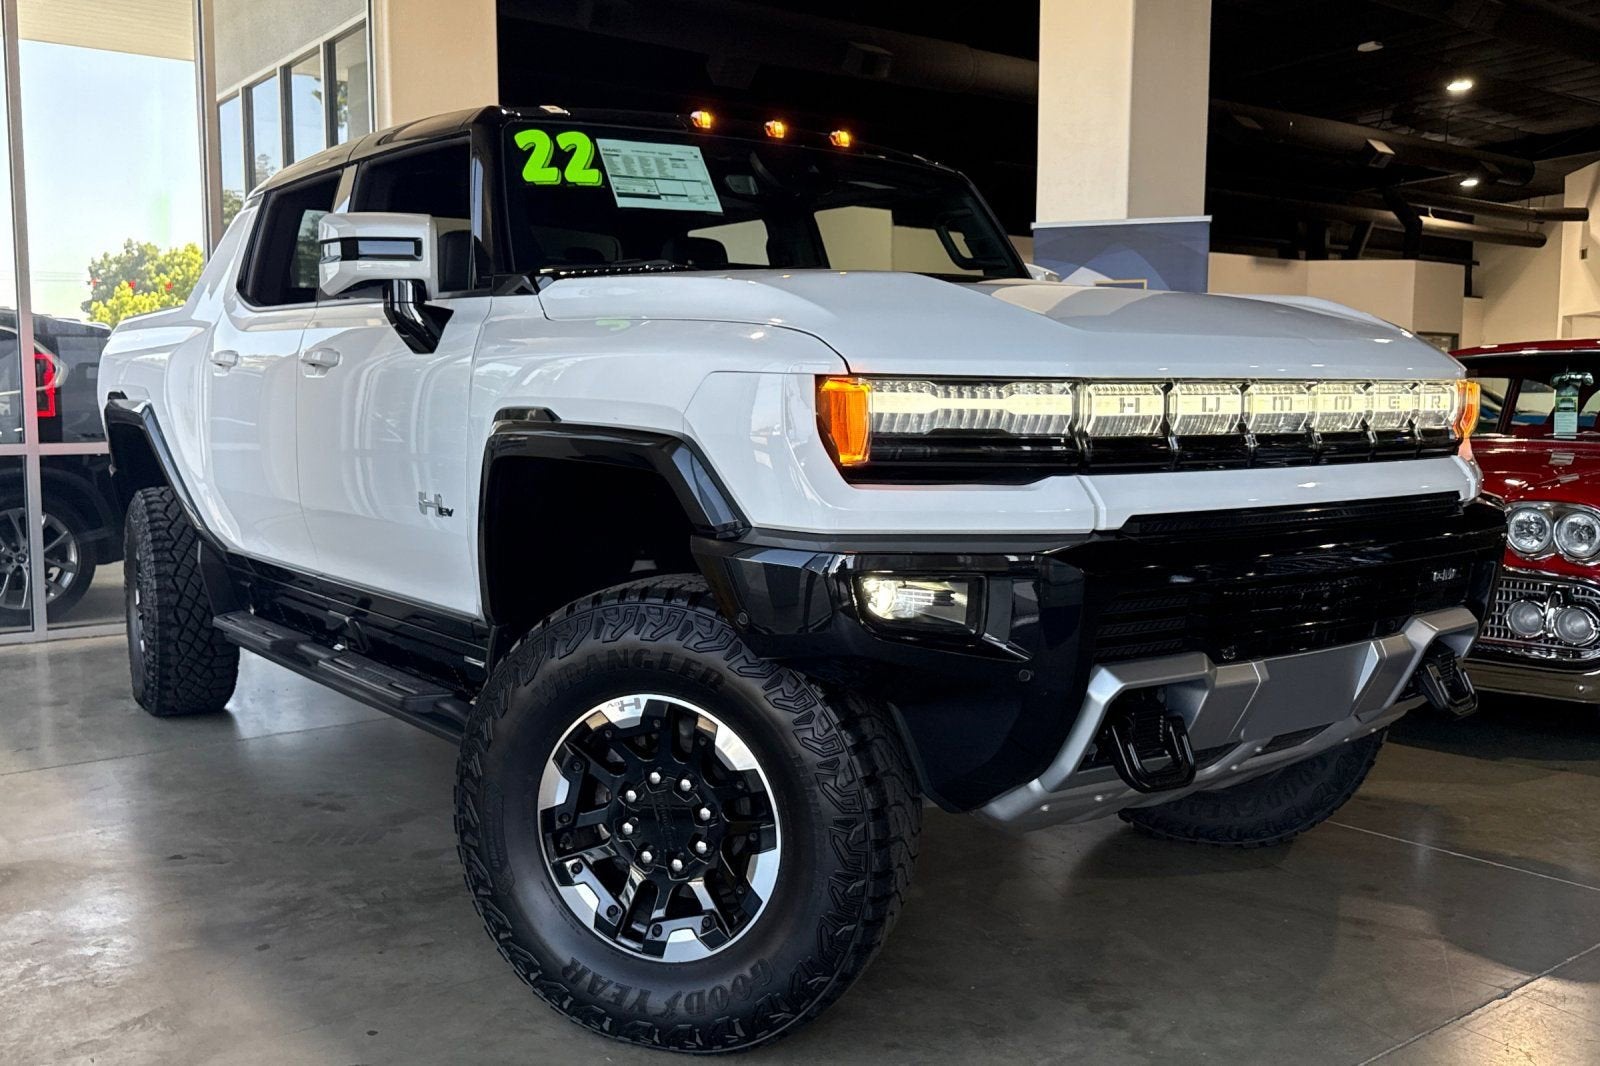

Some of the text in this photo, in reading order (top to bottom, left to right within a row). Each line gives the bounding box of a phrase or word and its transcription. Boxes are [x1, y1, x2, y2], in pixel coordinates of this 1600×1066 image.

[514, 129, 602, 186] 22
[1118, 394, 1441, 414] HUMMER
[532, 648, 725, 702] WRANGLER
